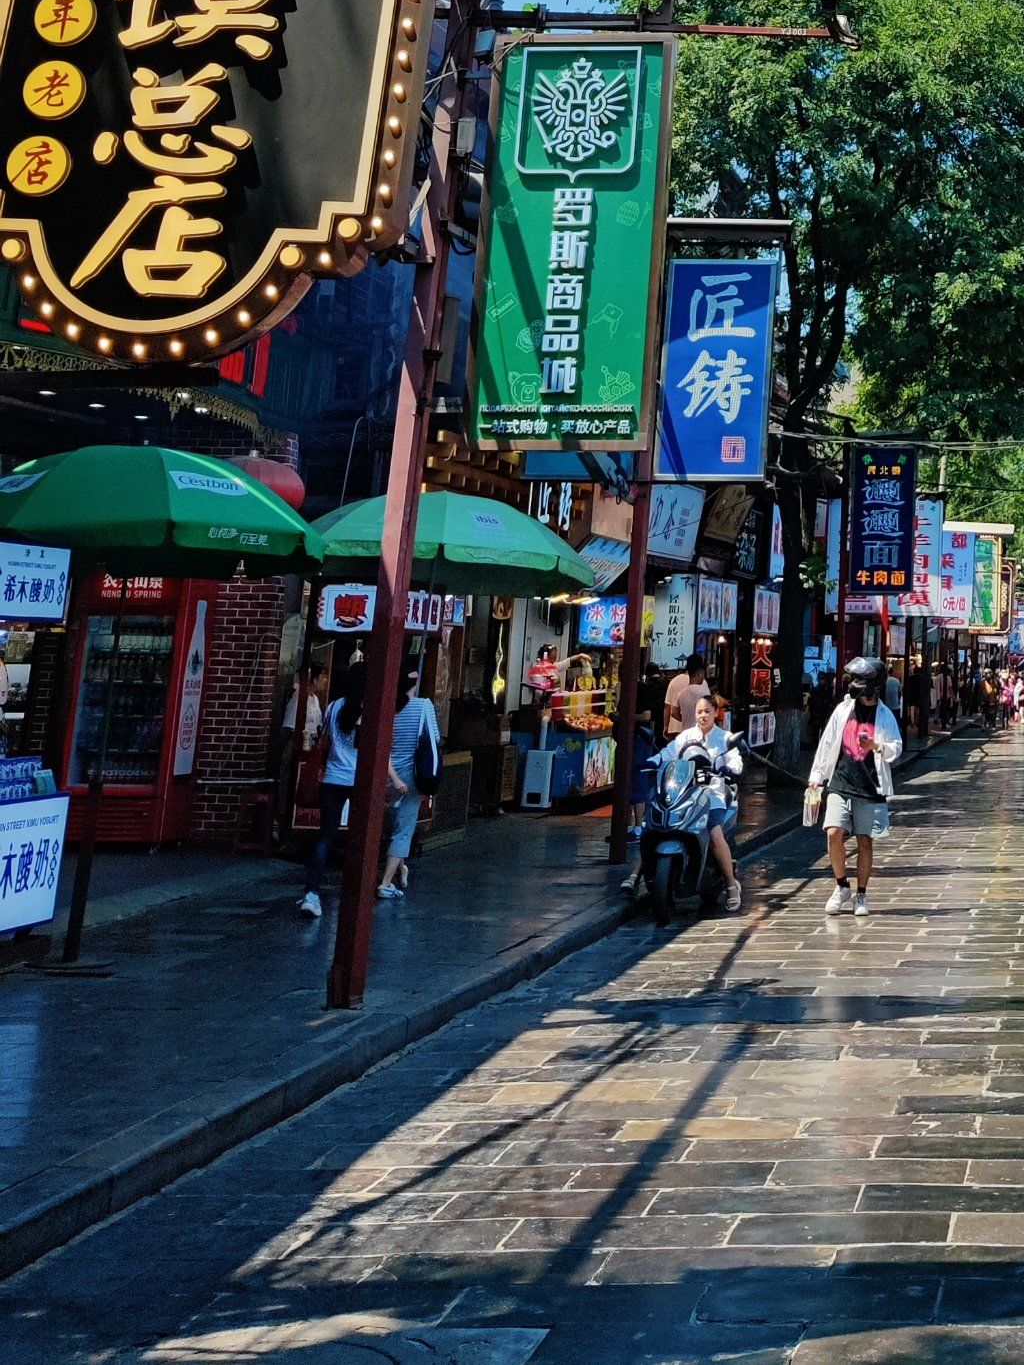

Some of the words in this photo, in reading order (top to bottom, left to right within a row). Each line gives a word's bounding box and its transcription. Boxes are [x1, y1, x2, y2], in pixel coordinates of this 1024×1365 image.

[539, 188, 593, 395] 罗斯商品城
[677, 272, 757, 424] 匠铸
[178, 475, 239, 492] C'estbon
[475, 514, 499, 525] ibis
[856, 570, 906, 586] 牛肉面
[3, 574, 56, 604] 希木酸奶
[101, 590, 131, 599] NONGU
[134, 590, 162, 599] SPRING
